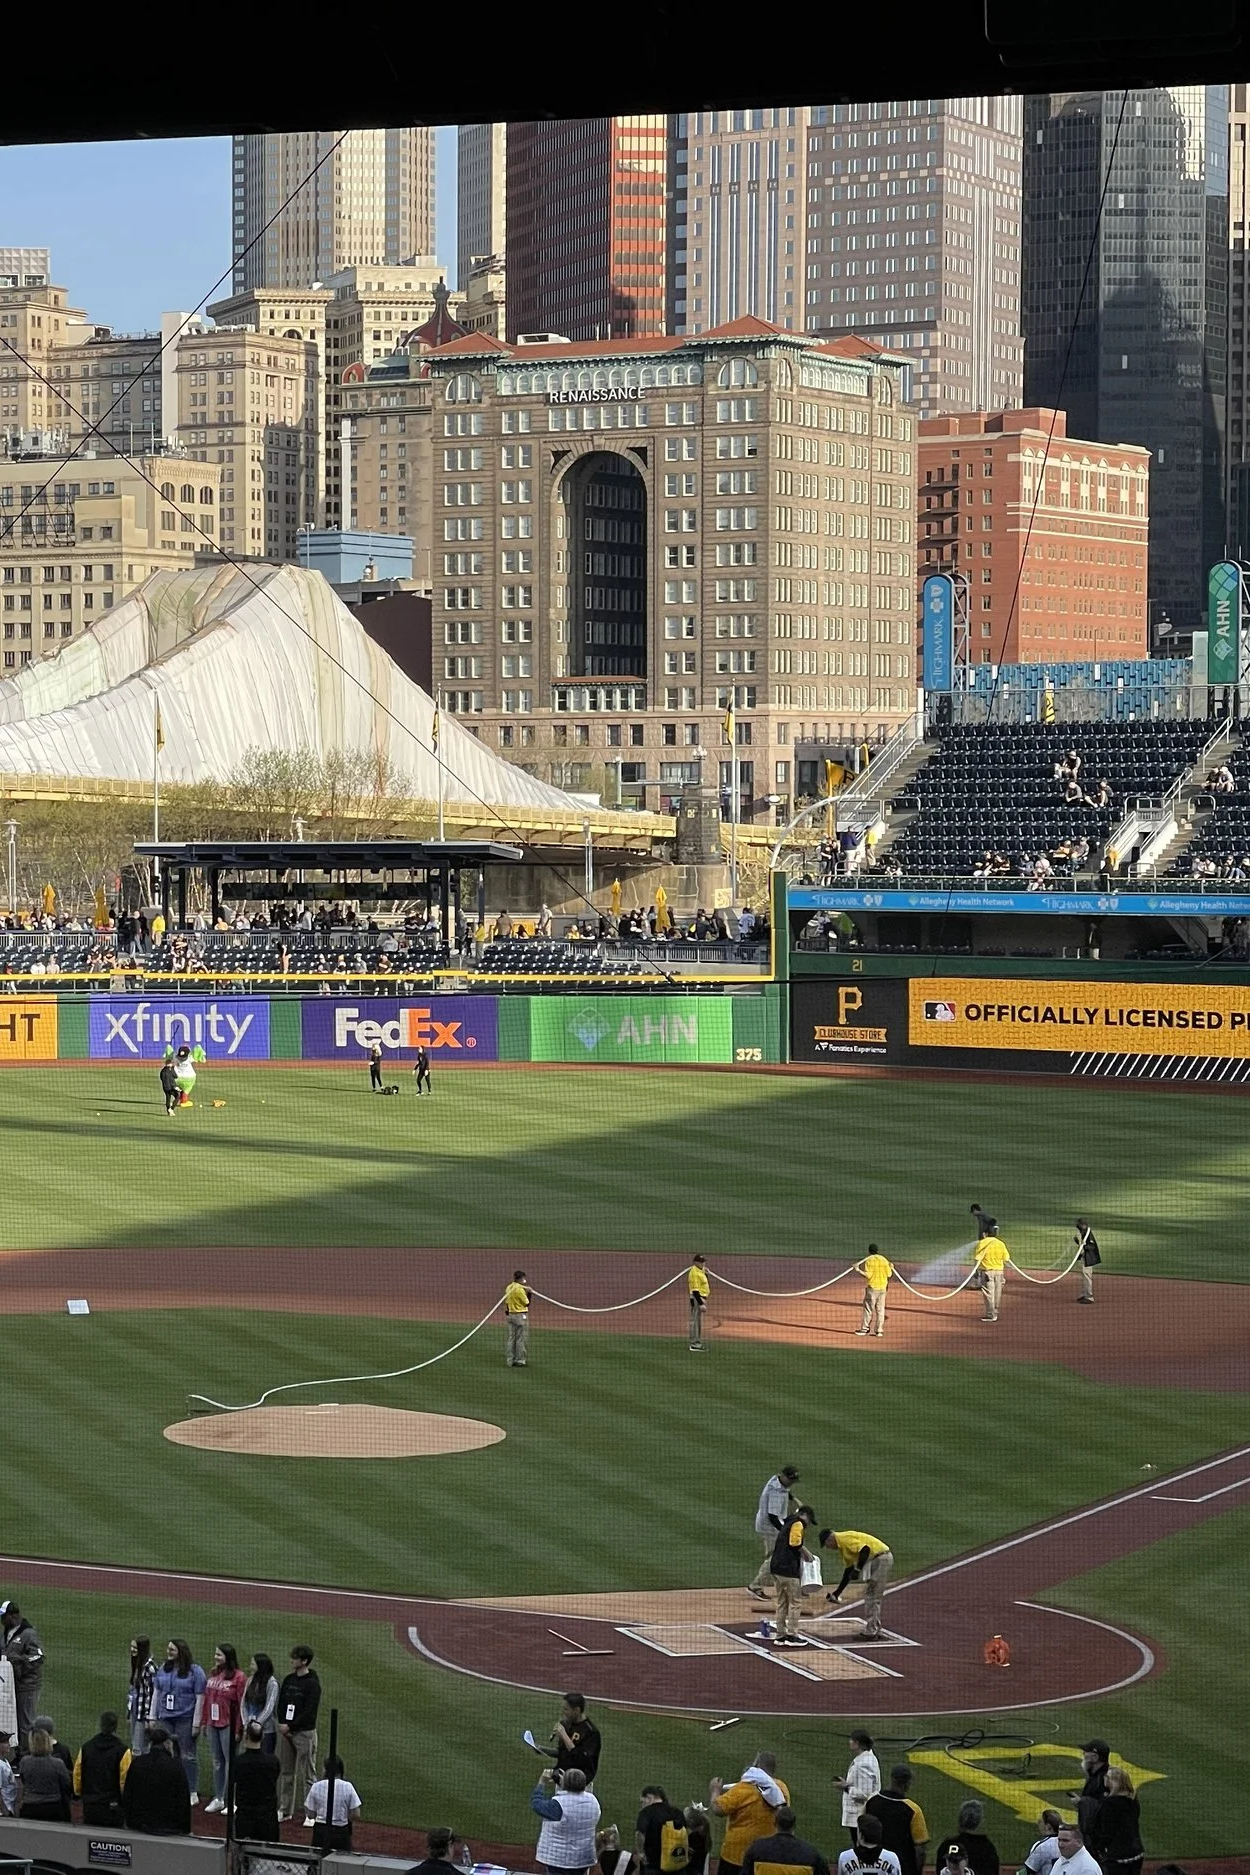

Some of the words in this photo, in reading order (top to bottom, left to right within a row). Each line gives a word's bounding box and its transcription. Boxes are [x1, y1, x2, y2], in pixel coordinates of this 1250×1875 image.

[550, 386, 646, 404] RENAISSANCE
[1216, 601, 1231, 637] AHN
[931, 617, 944, 689] HIGHMARK
[920, 898, 956, 906] Allegheny
[958, 898, 982, 906] Health
[983, 898, 1014, 906] Network
[1160, 900, 1200, 910] Allegheny
[1201, 900, 1227, 909] Health
[852, 960, 862, 971] 21
[838, 987, 862, 1024] P
[964, 1003, 1100, 1025] OFFICIALLY
[1105, 1008, 1223, 1029] LICENSED
[1230, 1012, 1250, 1030] P
[104, 1002, 255, 1054] xfinity
[335, 1008, 463, 1048] FedEx
[617, 1014, 697, 1045] AHN
[819, 1028, 858, 1039] CLUBHOUSE
[860, 1030, 882, 1039] STORE
[736, 1048, 762, 1061] 375
[829, 1044, 853, 1052] Fanatics
[90, 1841, 130, 1853] CAUTION
[949, 1845, 959, 1855] P
